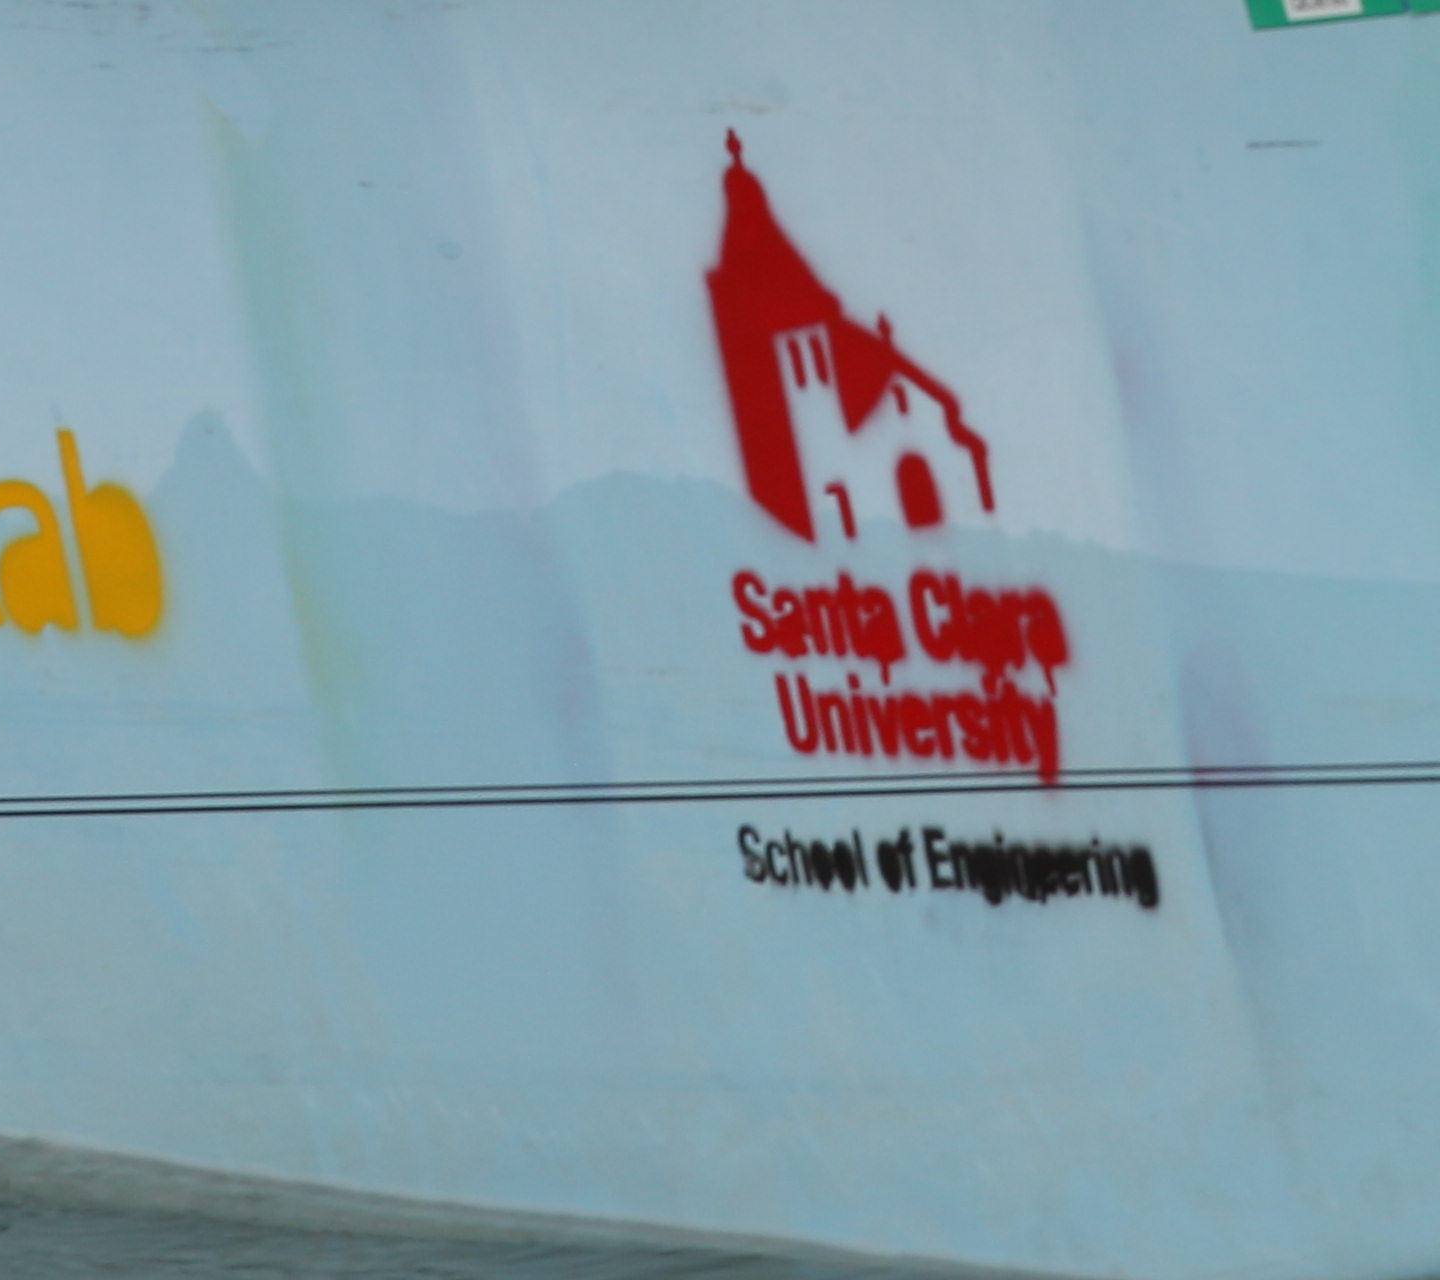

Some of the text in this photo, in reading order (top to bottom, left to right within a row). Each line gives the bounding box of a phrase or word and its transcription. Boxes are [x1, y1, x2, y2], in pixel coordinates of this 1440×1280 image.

[732, 565, 1073, 671] Santa Clara
[775, 670, 1062, 789] University
[736, 824, 1161, 912] School of Engineering
